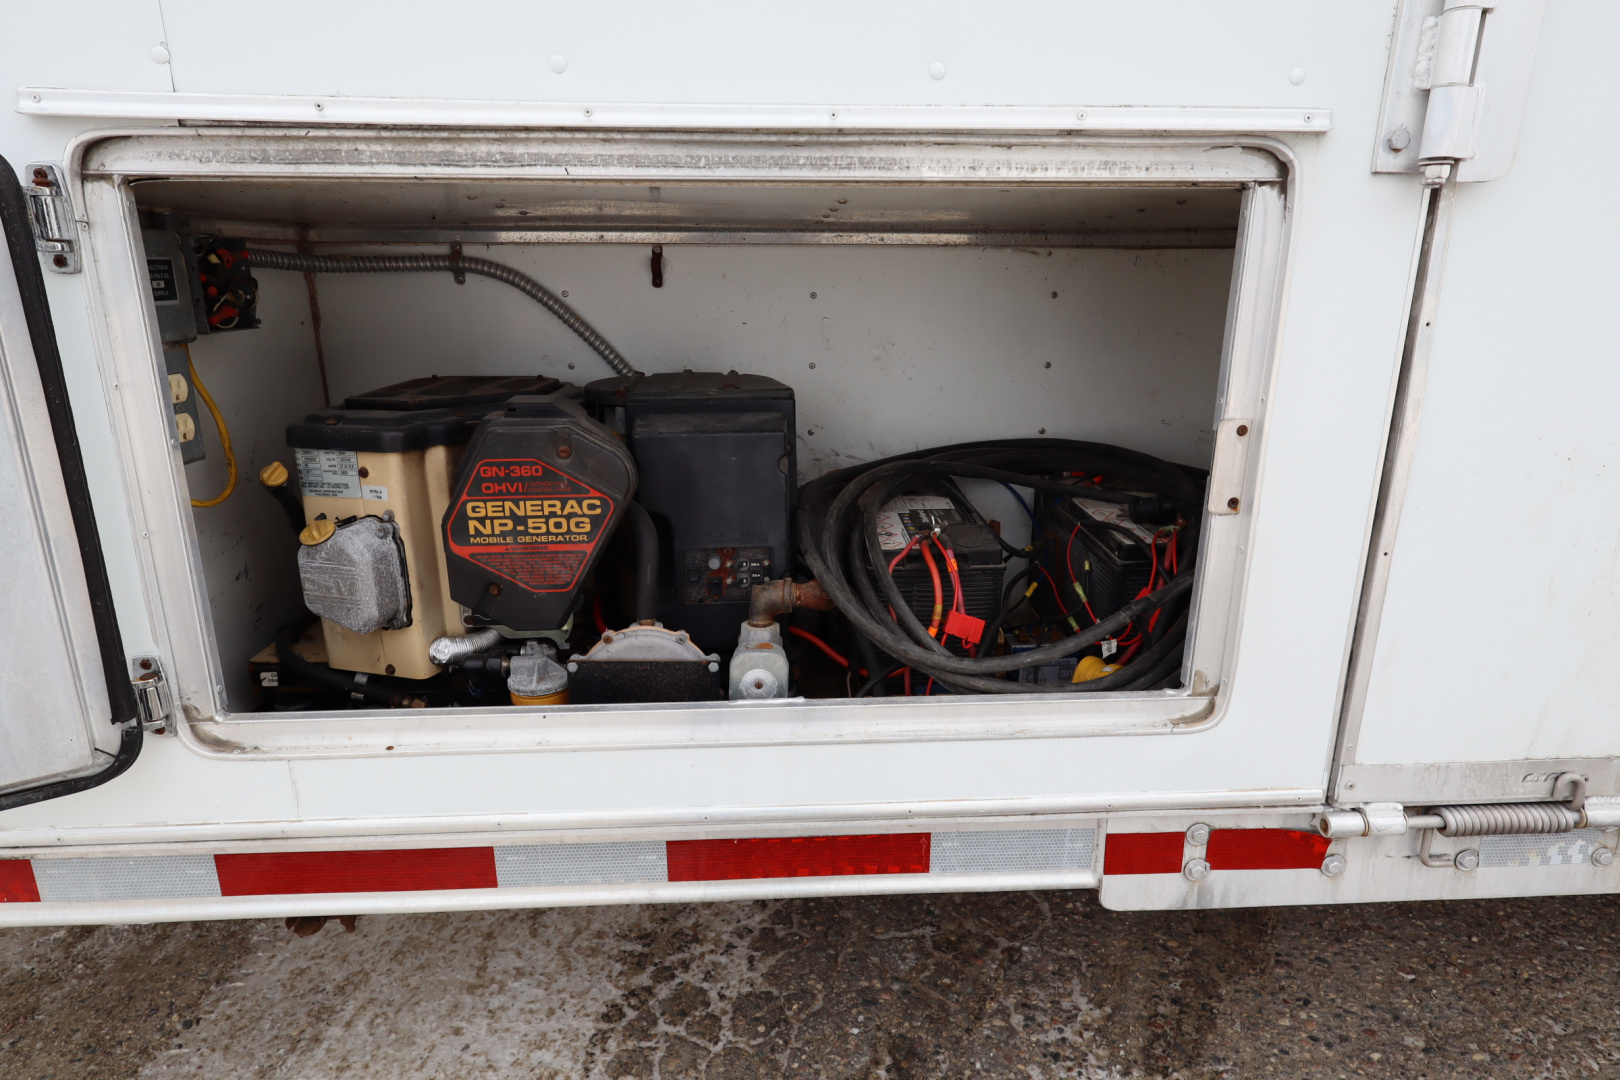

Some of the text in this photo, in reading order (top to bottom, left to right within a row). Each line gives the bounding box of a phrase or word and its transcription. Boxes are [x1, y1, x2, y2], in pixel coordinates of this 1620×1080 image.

[480, 465, 543, 478] GN-360
[466, 499, 602, 518] GENERAC
[468, 517, 592, 535] NP-50G
[470, 534, 589, 544] MOBILE GENERATOR
